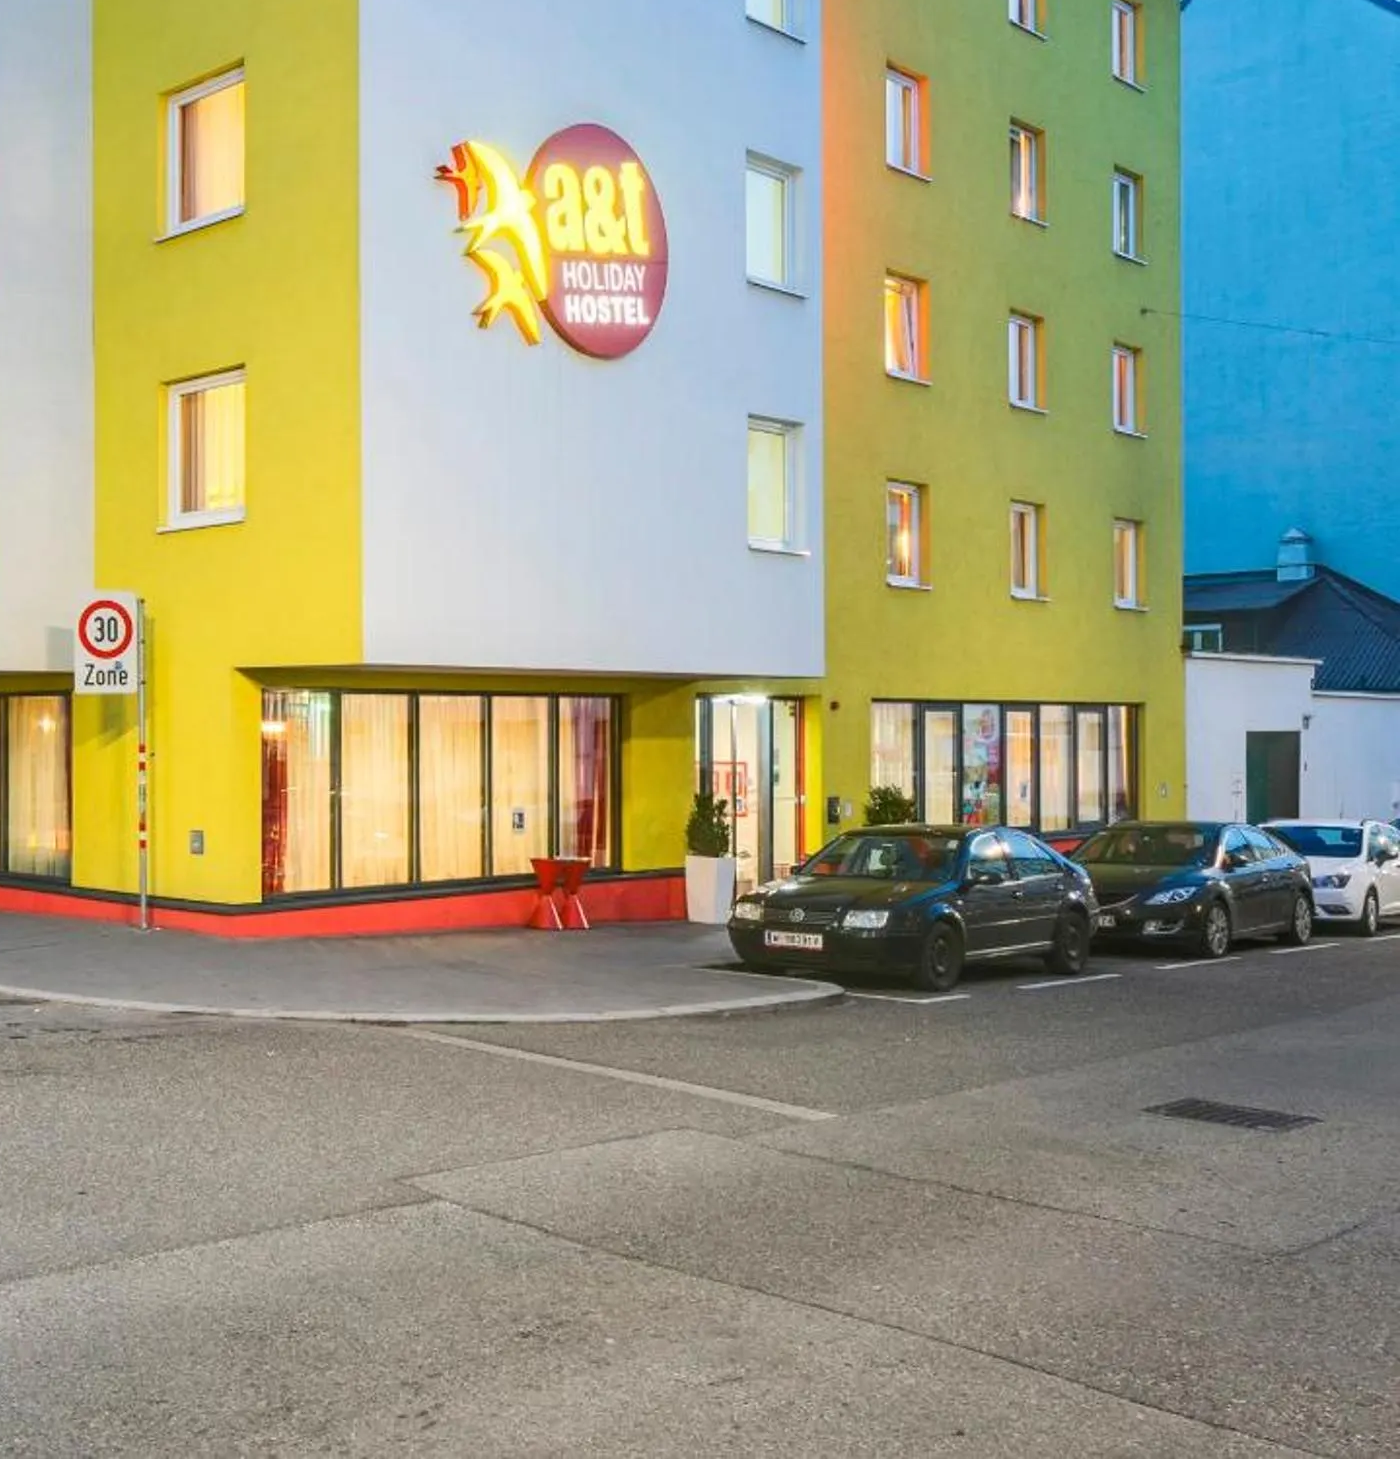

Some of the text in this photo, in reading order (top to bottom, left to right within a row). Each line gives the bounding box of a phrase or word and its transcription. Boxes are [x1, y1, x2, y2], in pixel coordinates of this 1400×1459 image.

[562, 261, 646, 292] HOLIDAY
[564, 294, 650, 326] HOSTEL
[93, 615, 119, 643] 30
[84, 663, 129, 686] Zone
